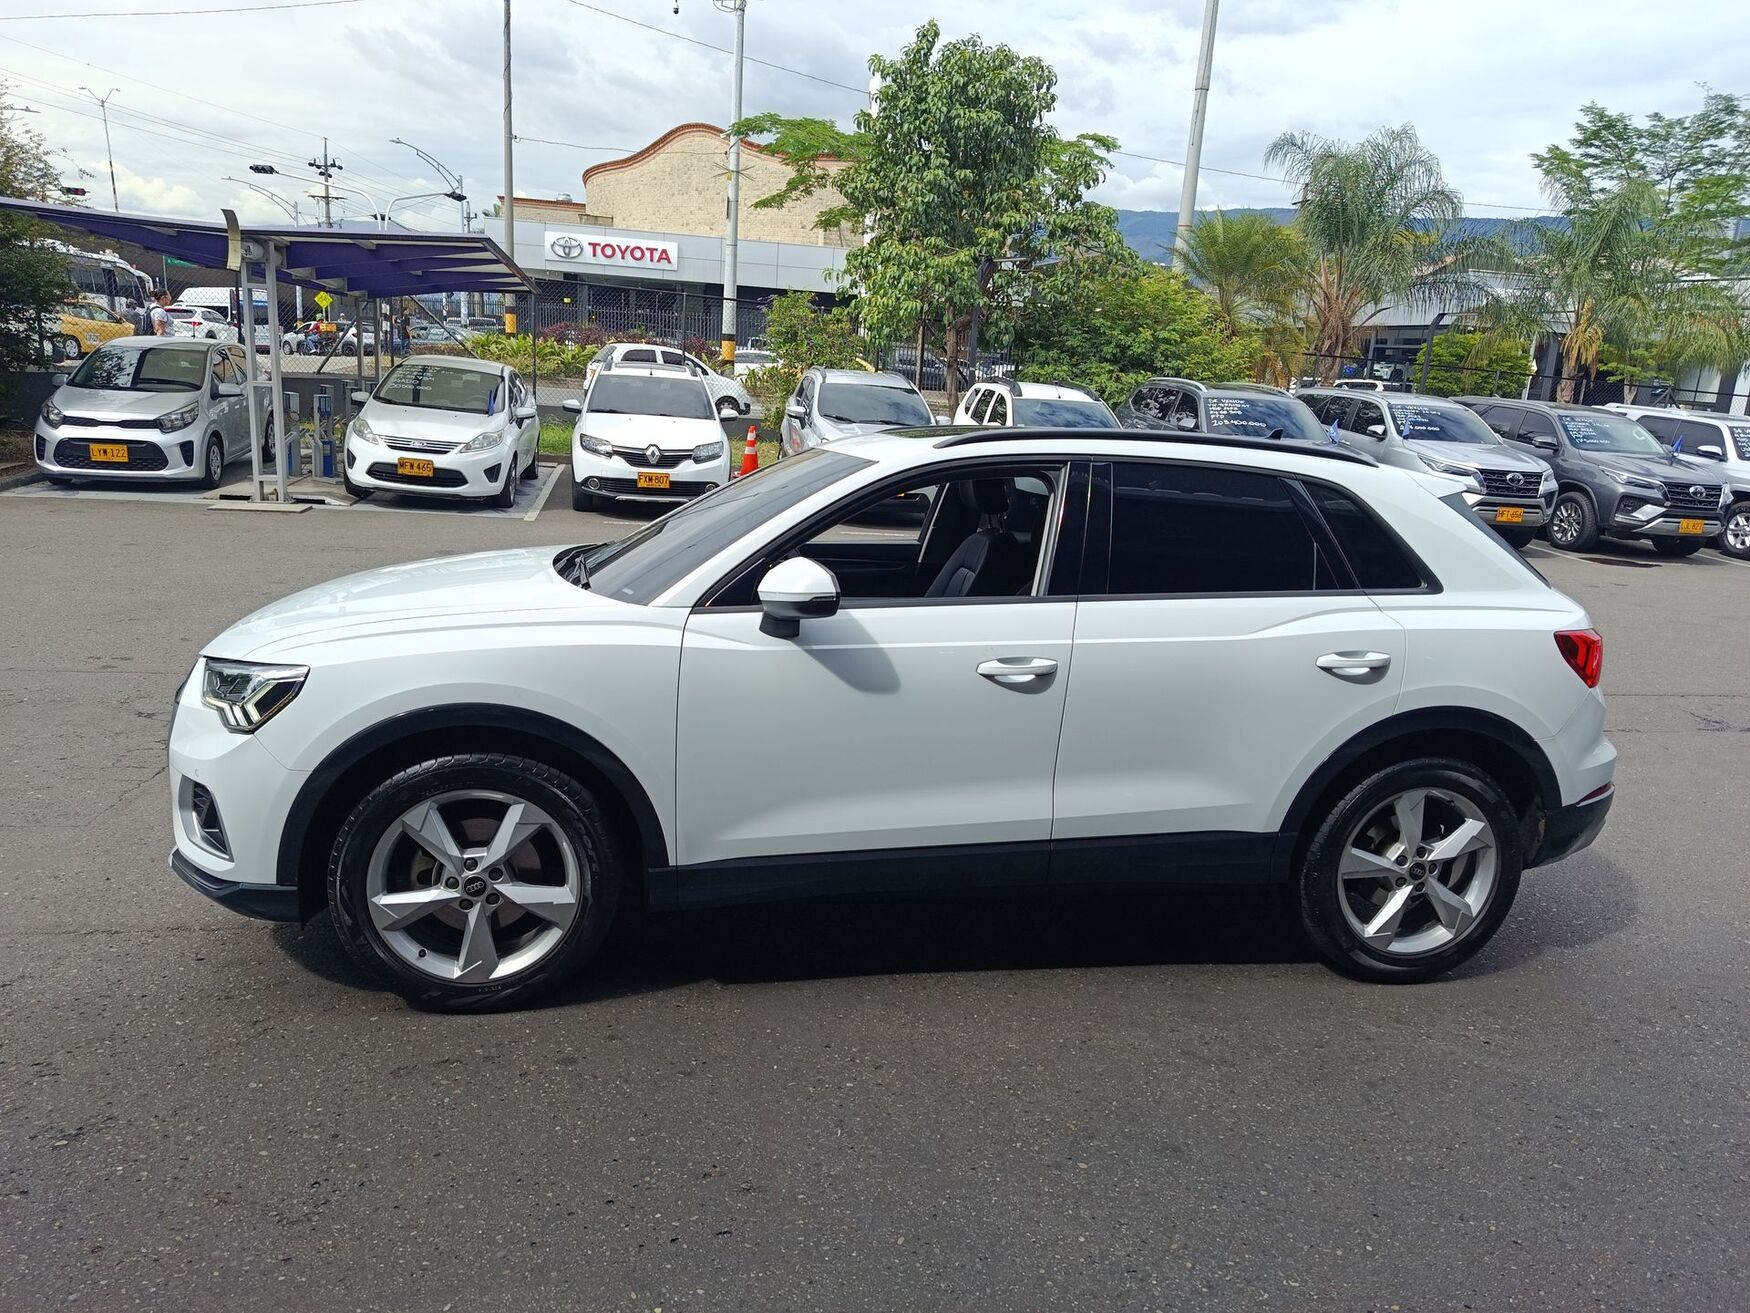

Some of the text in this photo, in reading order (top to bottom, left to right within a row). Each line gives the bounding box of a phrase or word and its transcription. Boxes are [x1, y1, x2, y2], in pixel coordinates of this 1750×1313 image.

[588, 242, 672, 264] TOYOTA
[110, 448, 127, 458] 122
[654, 475, 669, 485] 807
